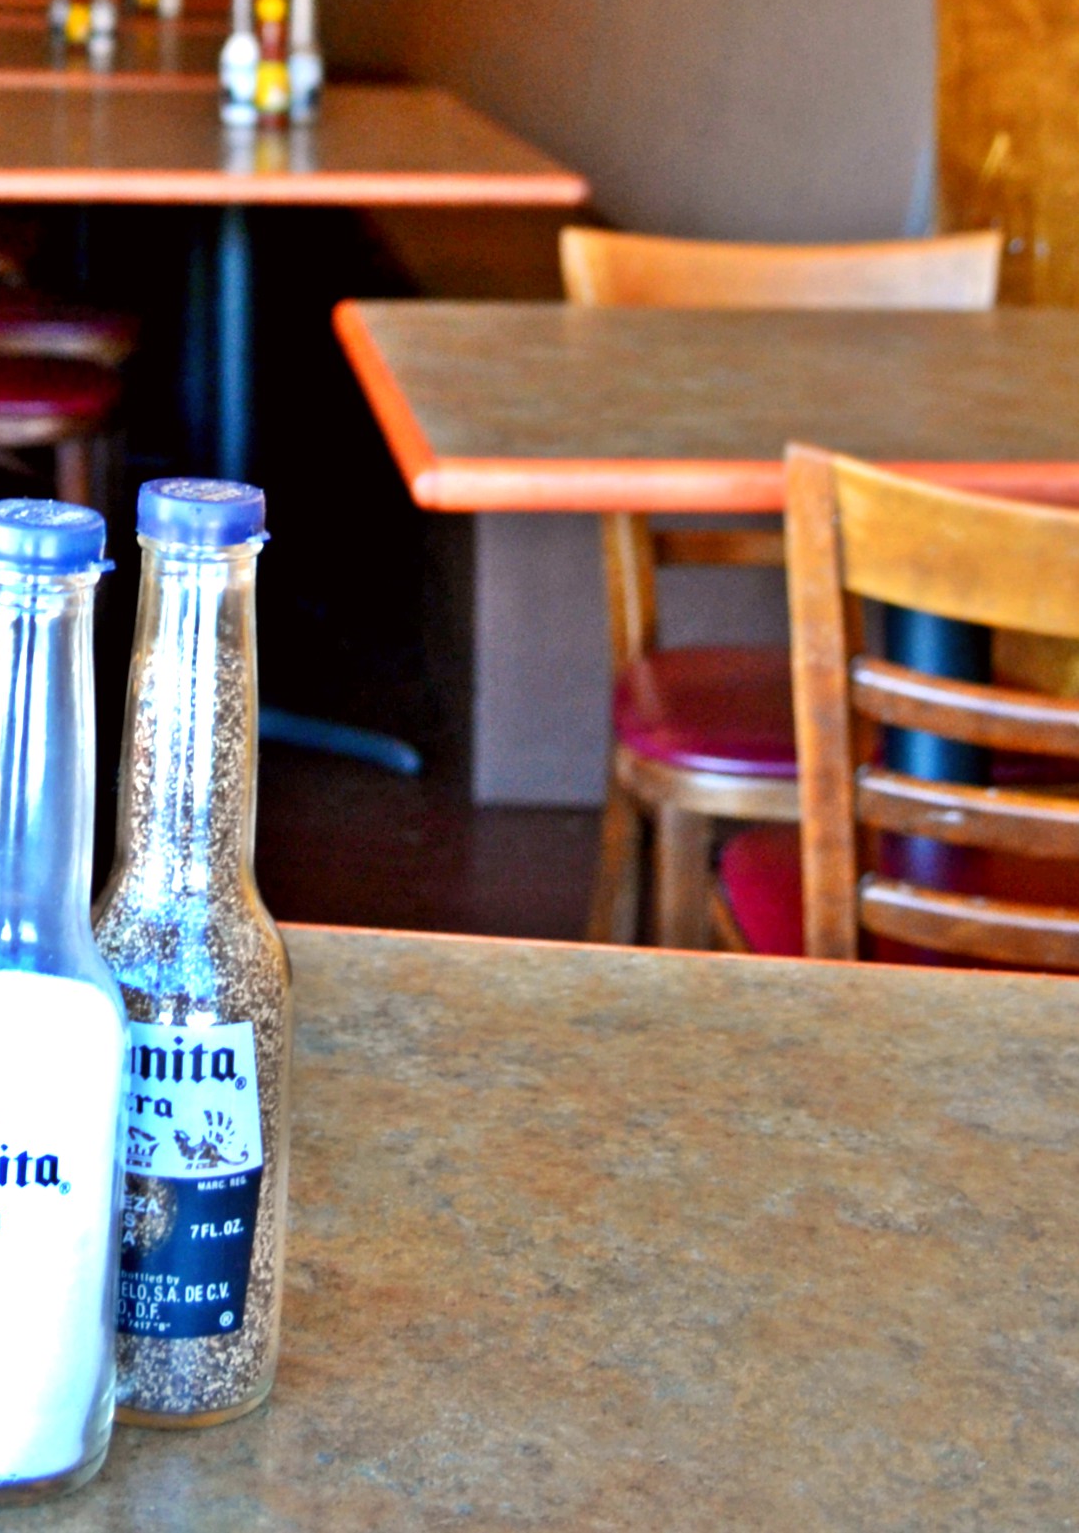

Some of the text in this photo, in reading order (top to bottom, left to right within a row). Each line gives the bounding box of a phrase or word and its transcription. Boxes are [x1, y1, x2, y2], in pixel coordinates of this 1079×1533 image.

[131, 1035, 238, 1084] nita
[129, 1091, 174, 1119] ra
[166, 1273, 180, 1286] by
[185, 1284, 204, 1303] DE
[206, 1281, 230, 1301] C.V.
